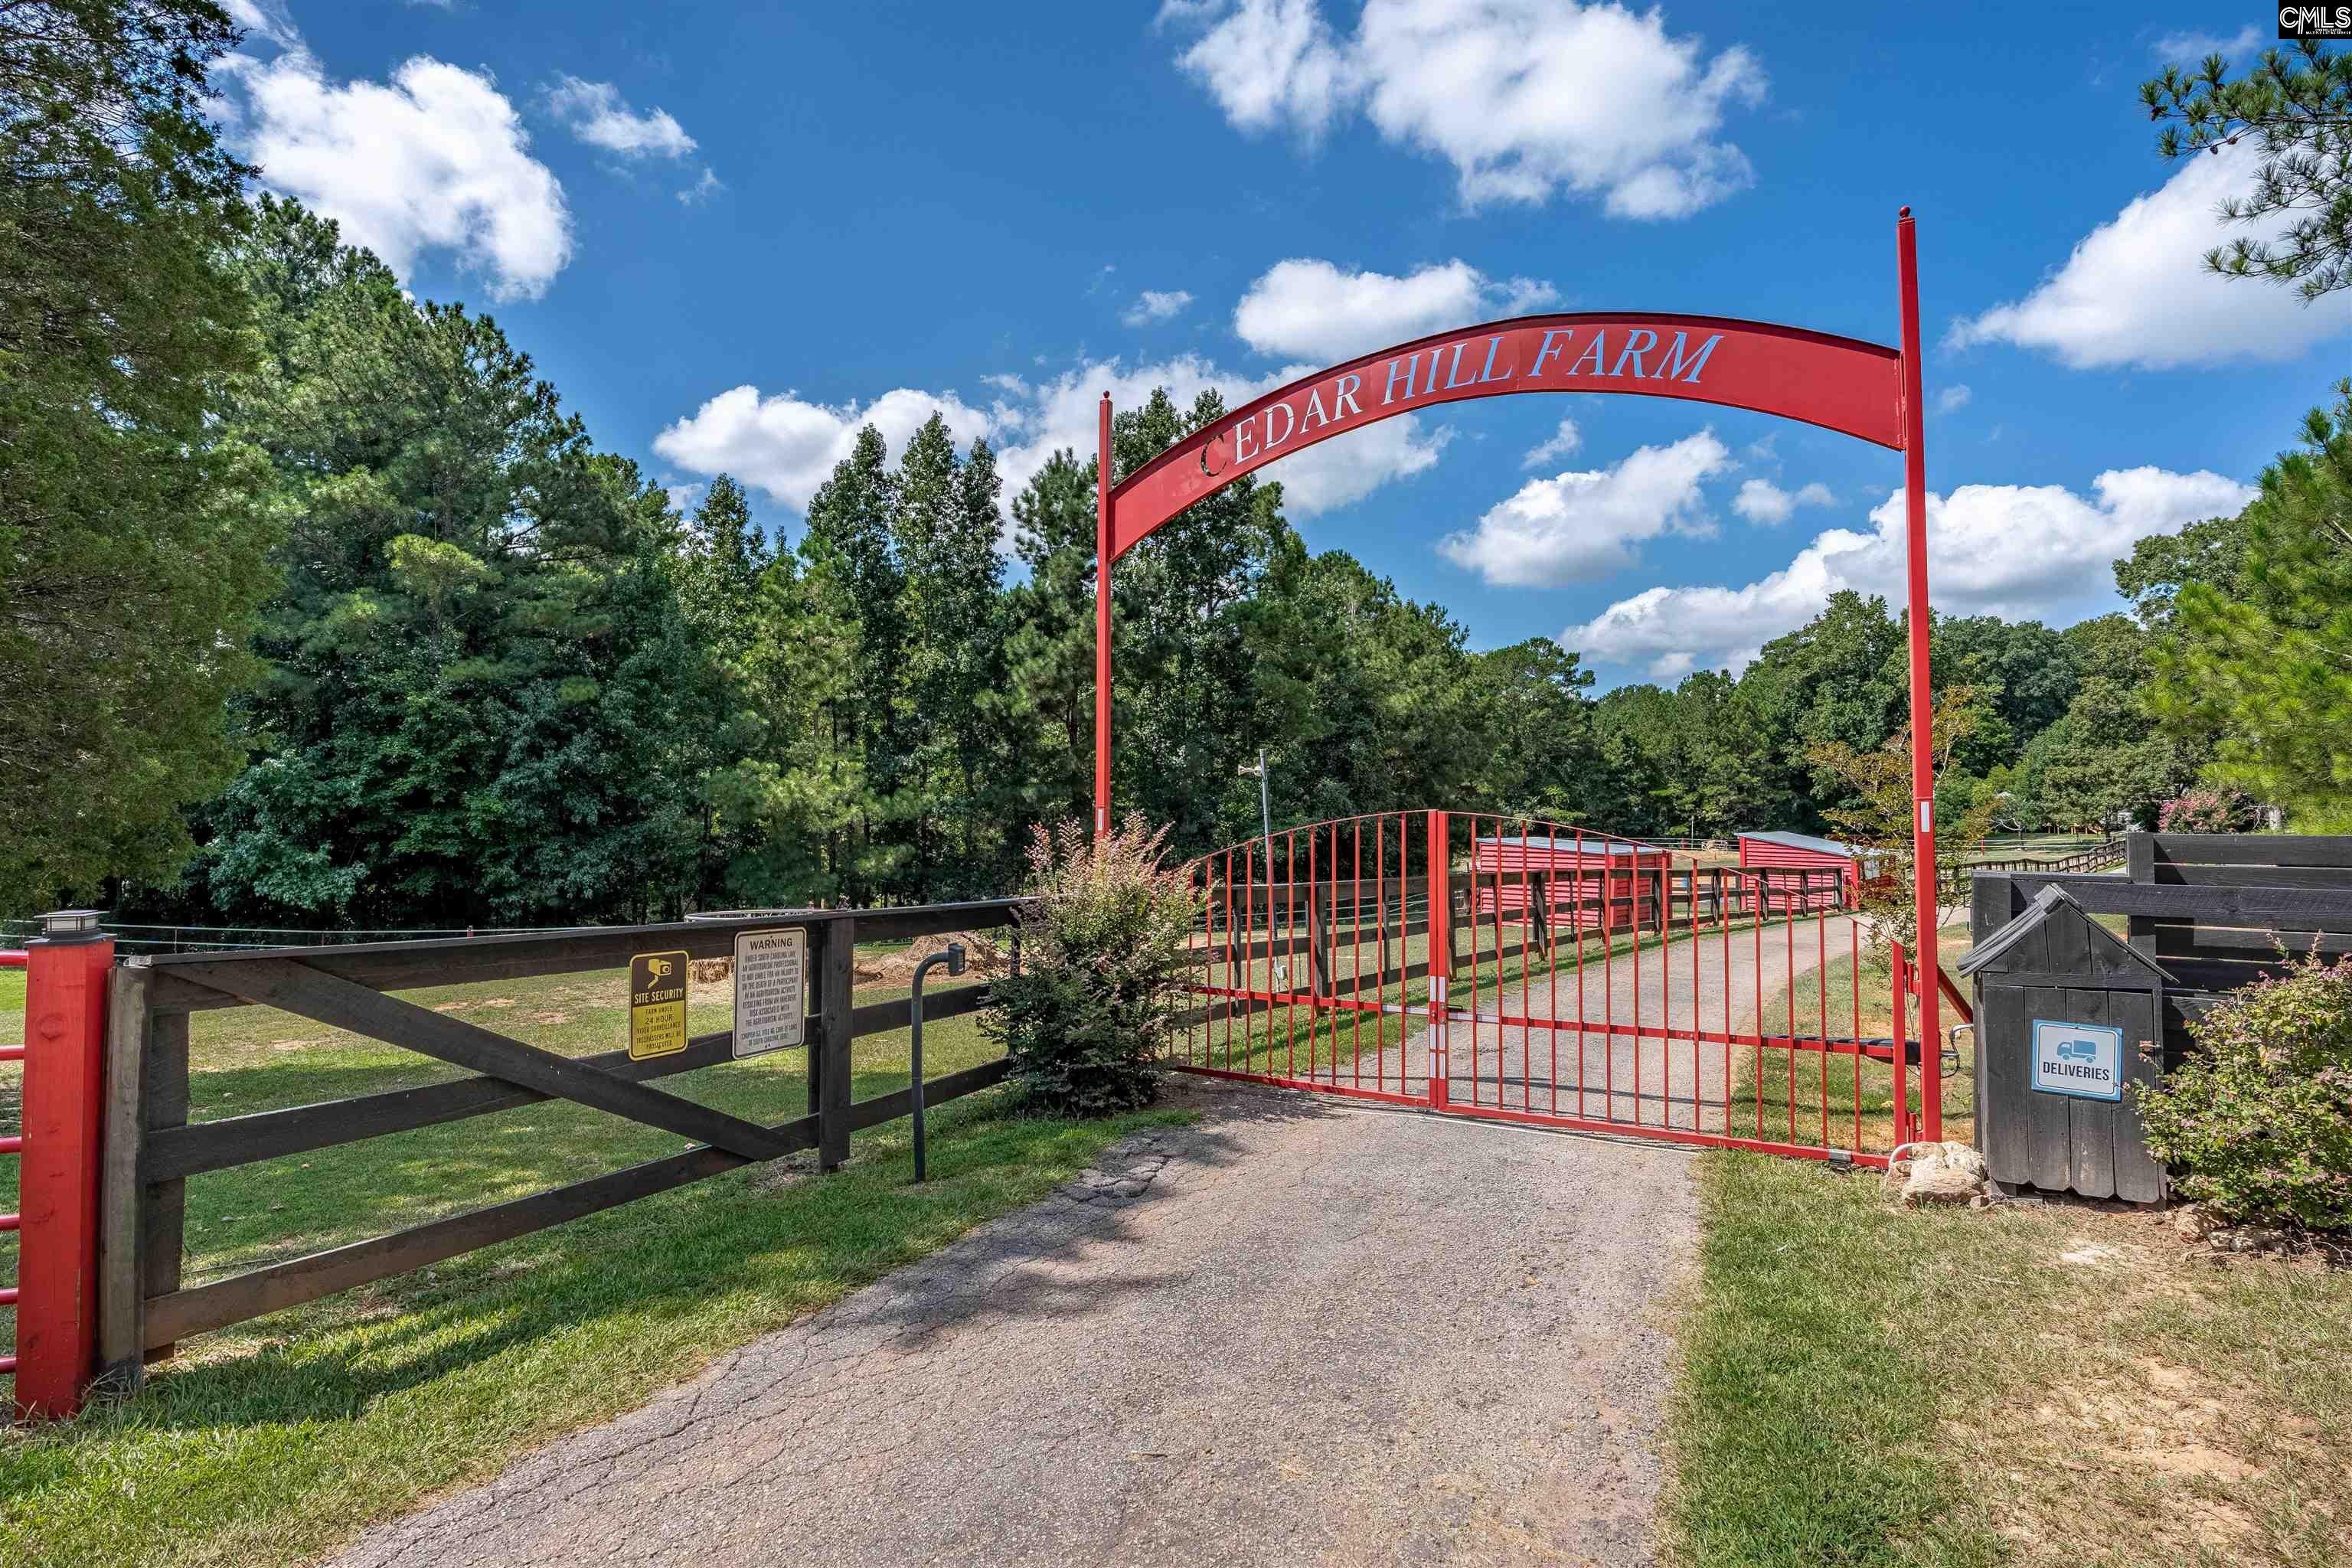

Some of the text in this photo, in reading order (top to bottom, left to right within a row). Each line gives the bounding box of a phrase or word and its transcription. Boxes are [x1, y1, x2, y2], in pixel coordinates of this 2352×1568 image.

[1200, 328, 1725, 477] CEDAR HILL FARM
[750, 938, 792, 950] WARNING
[634, 988, 683, 1004] SITE SECURITY
[656, 1014, 673, 1023] HOUR
[2043, 1062, 2109, 1081] DELIVERIES
